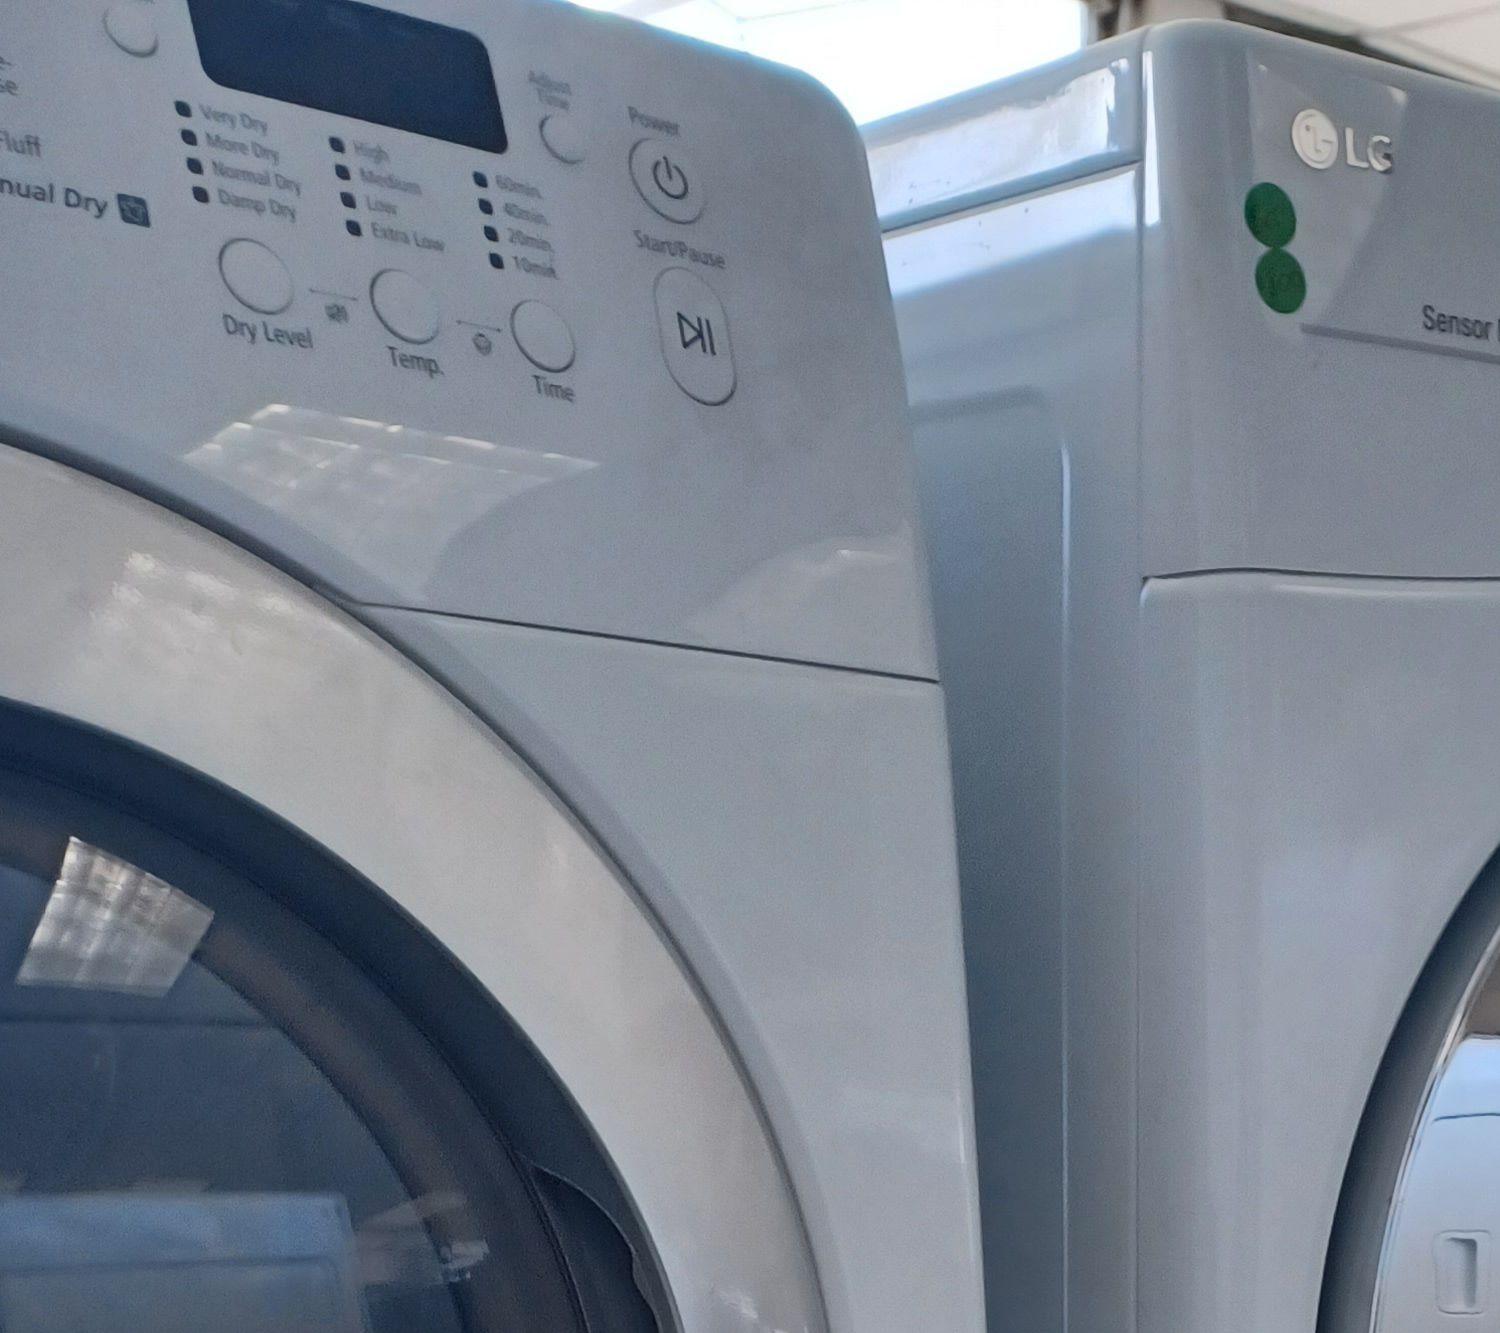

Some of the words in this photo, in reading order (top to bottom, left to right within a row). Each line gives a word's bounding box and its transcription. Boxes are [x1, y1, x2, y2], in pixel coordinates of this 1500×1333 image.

[201, 104, 237, 129] Very
[240, 113, 268, 134] Dry
[205, 133, 249, 155] More
[251, 143, 279, 165] Dry
[1345, 127, 1393, 173] LG
[212, 161, 271, 187] Normal
[274, 173, 302, 195] Dry
[64, 187, 108, 219] Dry
[269, 198, 297, 222] Dry
[222, 313, 258, 343] Dry
[263, 321, 313, 349] Level
[1422, 304, 1494, 342] Sensor
[532, 374, 575, 402] Time
